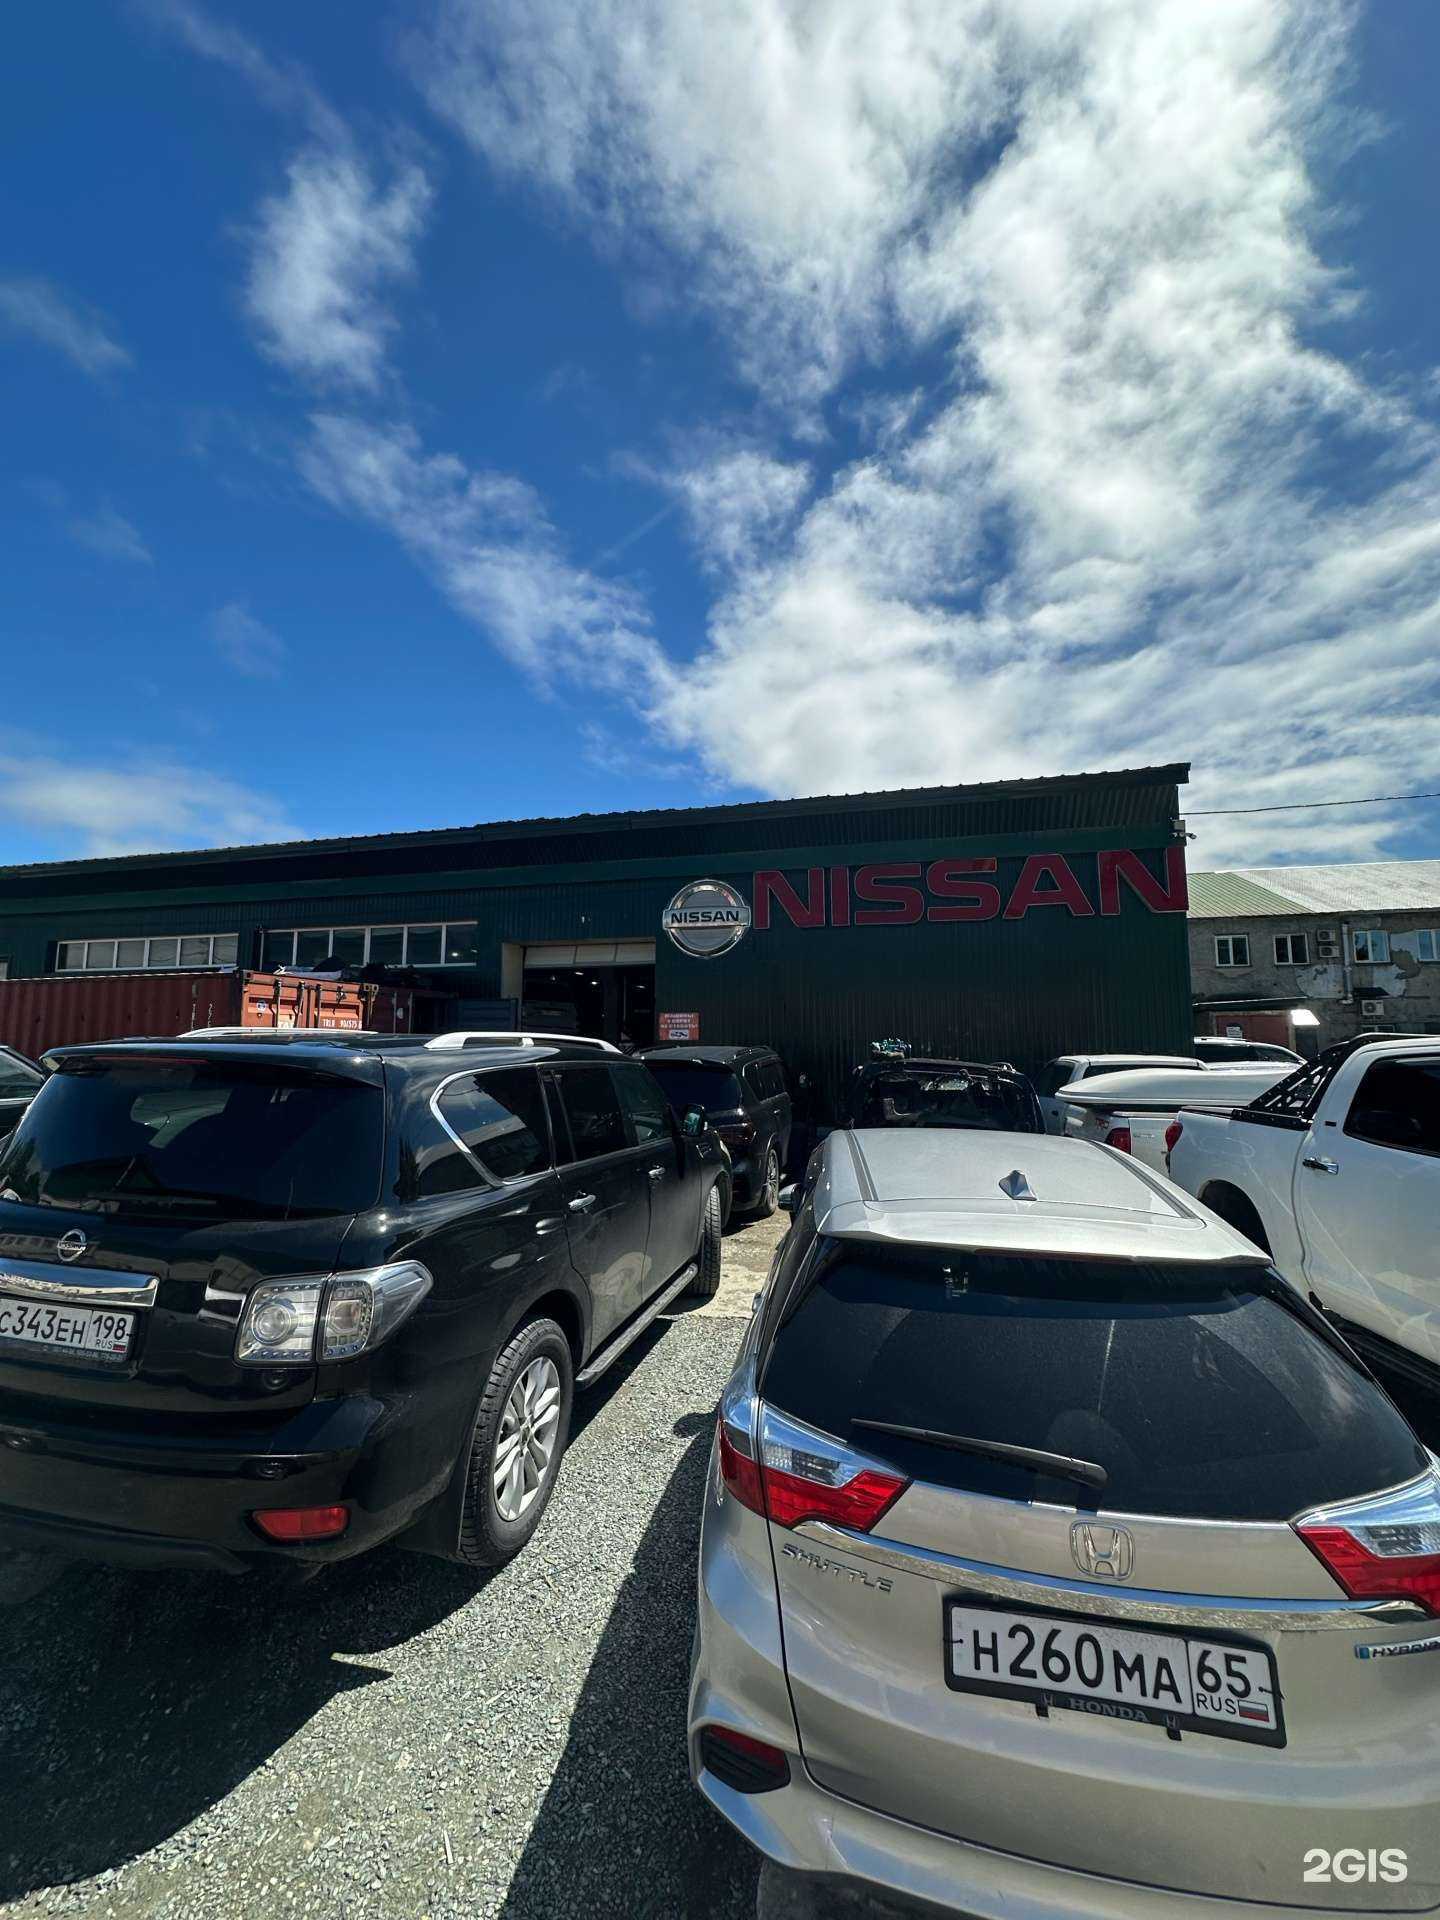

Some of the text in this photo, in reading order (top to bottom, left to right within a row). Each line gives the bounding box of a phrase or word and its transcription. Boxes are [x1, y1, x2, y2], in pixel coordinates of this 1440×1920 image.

[753, 847, 1188, 930] NISSAN
[671, 910, 740, 923] NISSAN
[93, 1314, 127, 1340] 198
[95, 1340, 113, 1350] RUS
[782, 1543, 893, 1593] SHUTTLE
[972, 1624, 1251, 1704] Н260МА 65
[1069, 1699, 1149, 1722] HONDA
[1197, 1693, 1237, 1715] RUS
